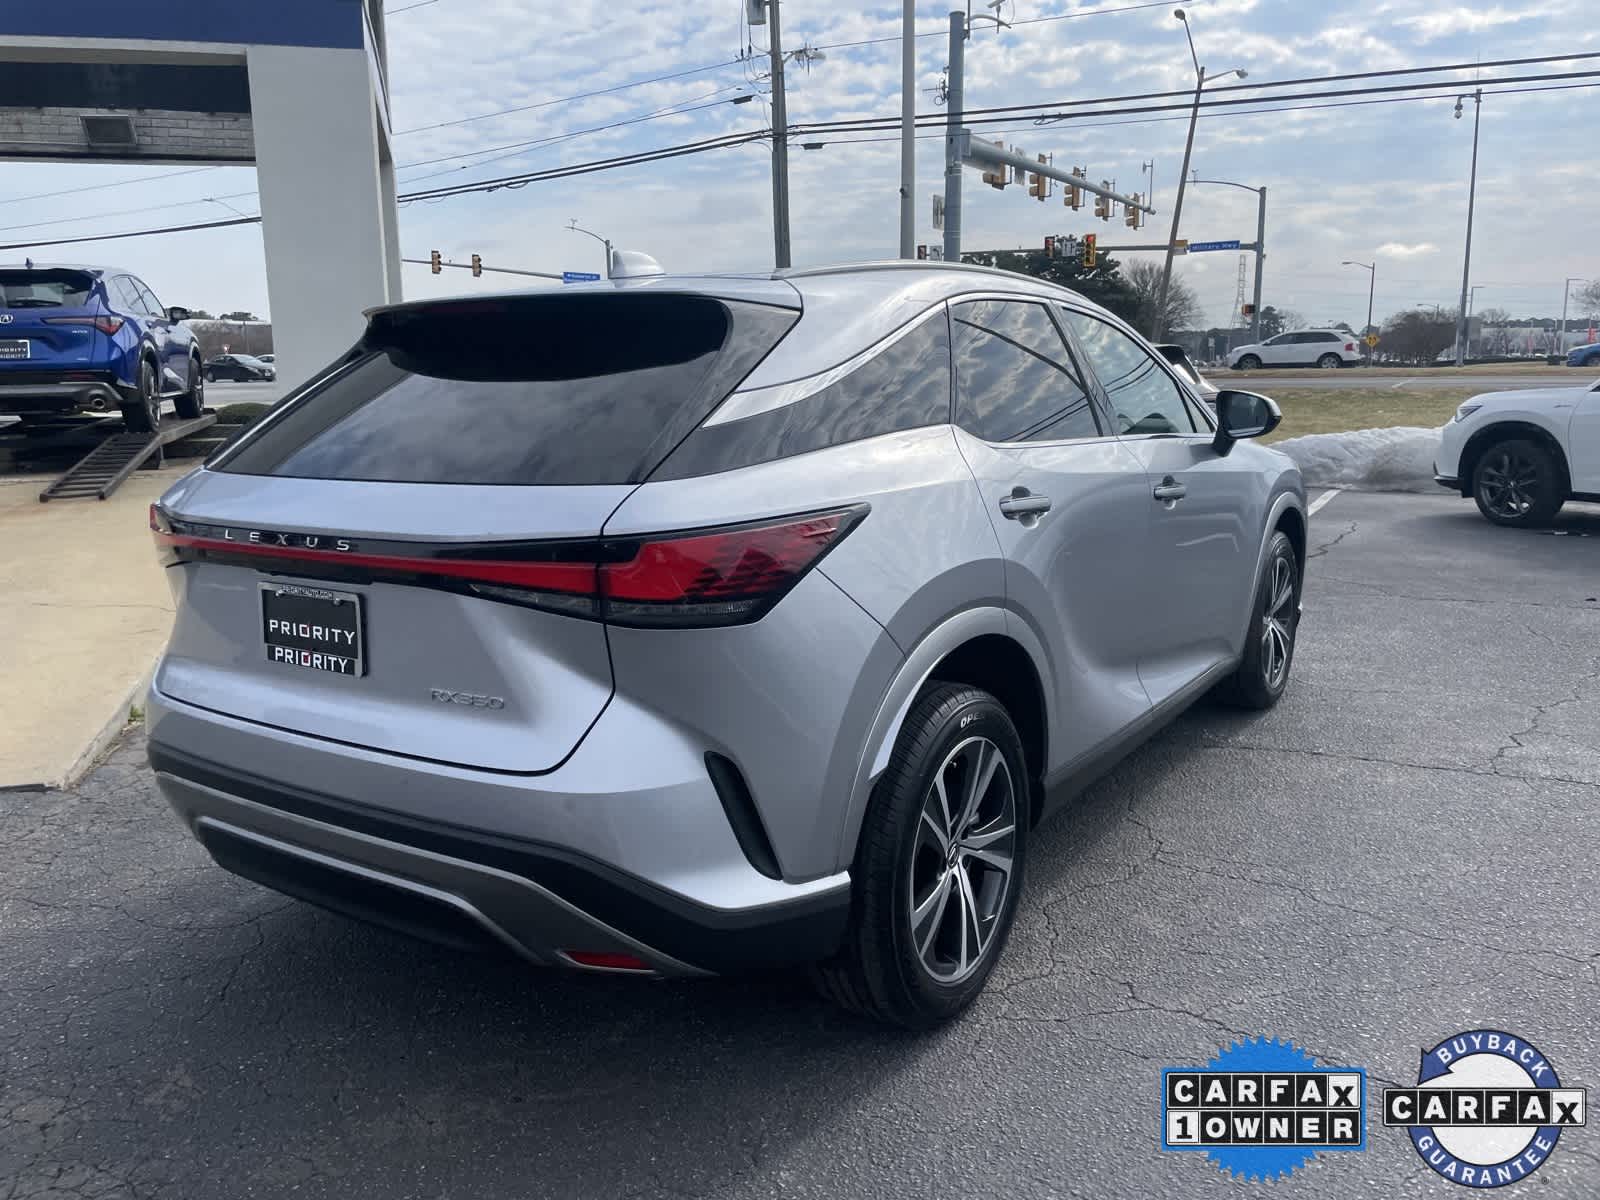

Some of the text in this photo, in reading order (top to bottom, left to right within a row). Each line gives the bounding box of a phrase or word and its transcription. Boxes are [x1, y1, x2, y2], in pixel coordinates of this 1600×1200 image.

[224, 529, 351, 552] LEXUS
[269, 619, 355, 645] PRIORITY
[274, 647, 348, 673] PRIORITY
